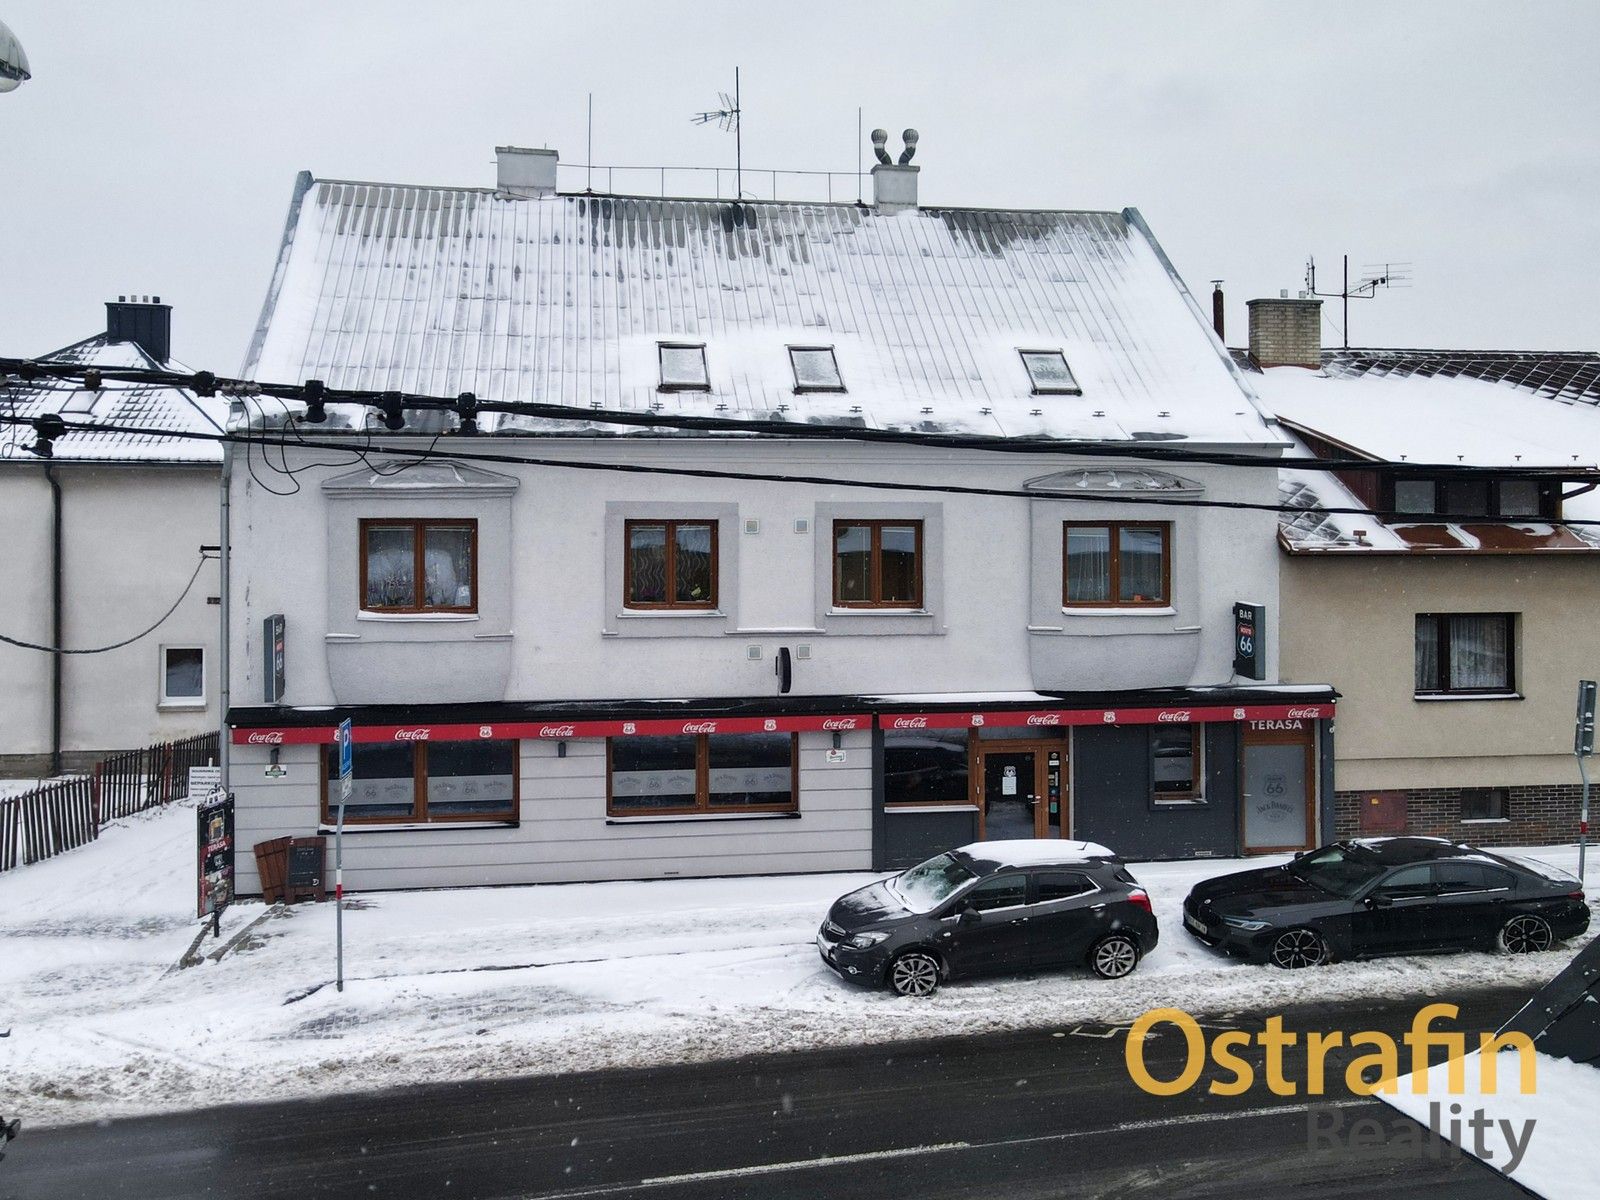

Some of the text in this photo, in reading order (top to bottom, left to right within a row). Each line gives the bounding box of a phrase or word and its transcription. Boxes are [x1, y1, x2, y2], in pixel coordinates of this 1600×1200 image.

[1239, 609, 1253, 620] BAR
[1240, 636, 1253, 653] 66
[1250, 719, 1303, 730] TERASA
[1266, 783, 1284, 794] 66
